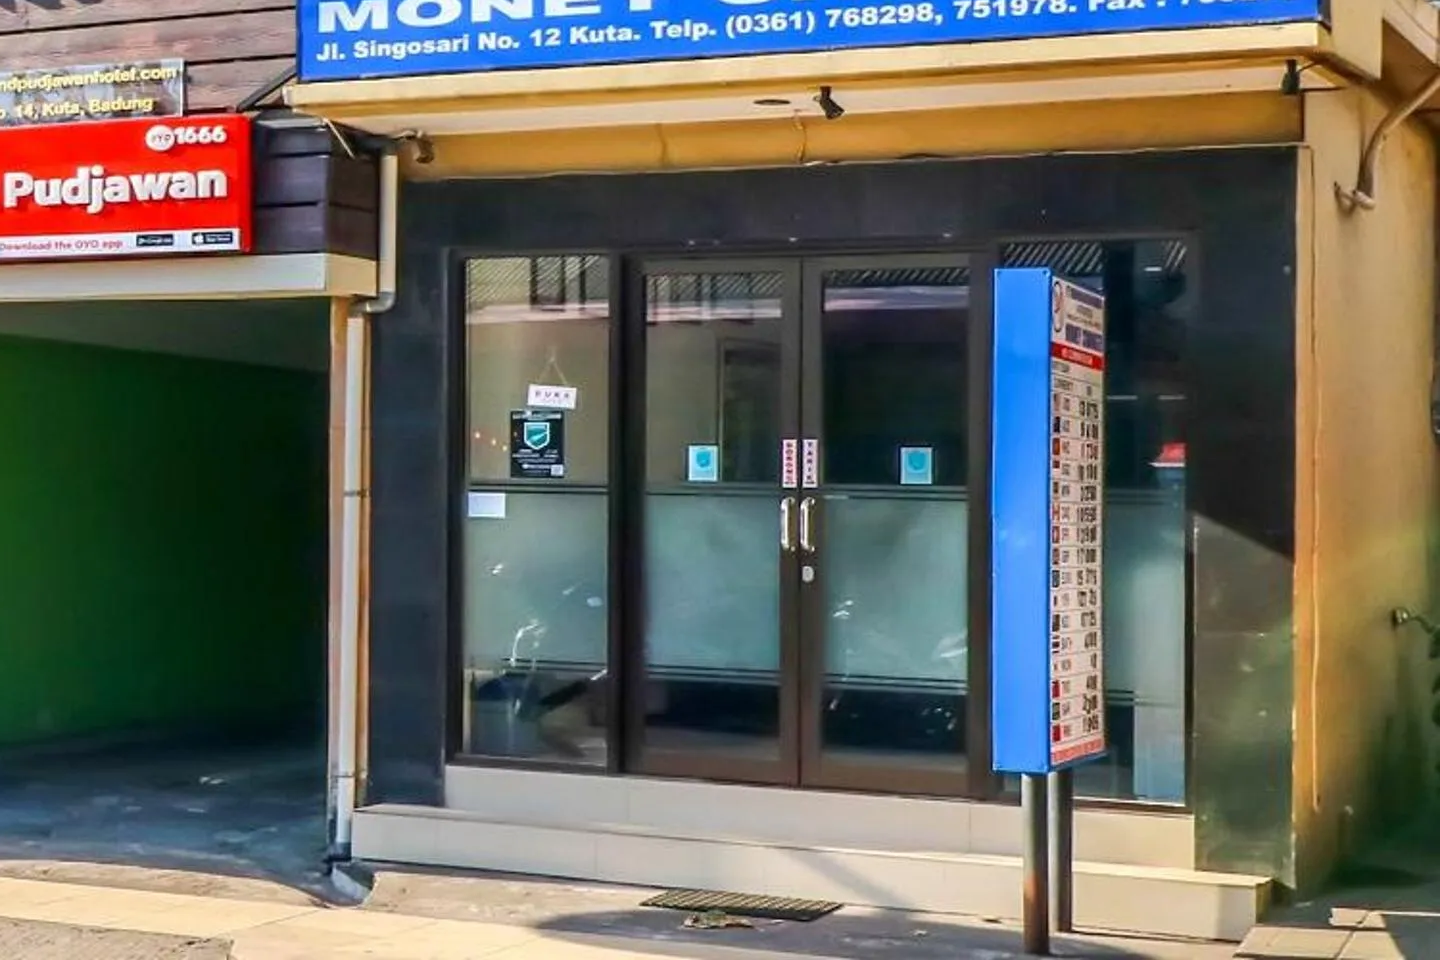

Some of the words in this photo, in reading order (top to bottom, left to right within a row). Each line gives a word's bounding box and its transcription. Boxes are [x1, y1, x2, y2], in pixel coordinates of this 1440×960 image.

[316, 42, 345, 61] Jl.
[353, 34, 469, 60] Singosari
[478, 32, 519, 50] No.
[530, 29, 560, 46] 12
[570, 25, 641, 44] Kuta.
[649, 19, 717, 41] Telp.
[726, 11, 816, 38] (0361)
[825, 2, 943, 28] 768298,
[89, 95, 155, 114] Badung
[174, 125, 228, 144] 1666
[3, 165, 228, 214] Pudjawan
[55, 240, 72, 250] the
